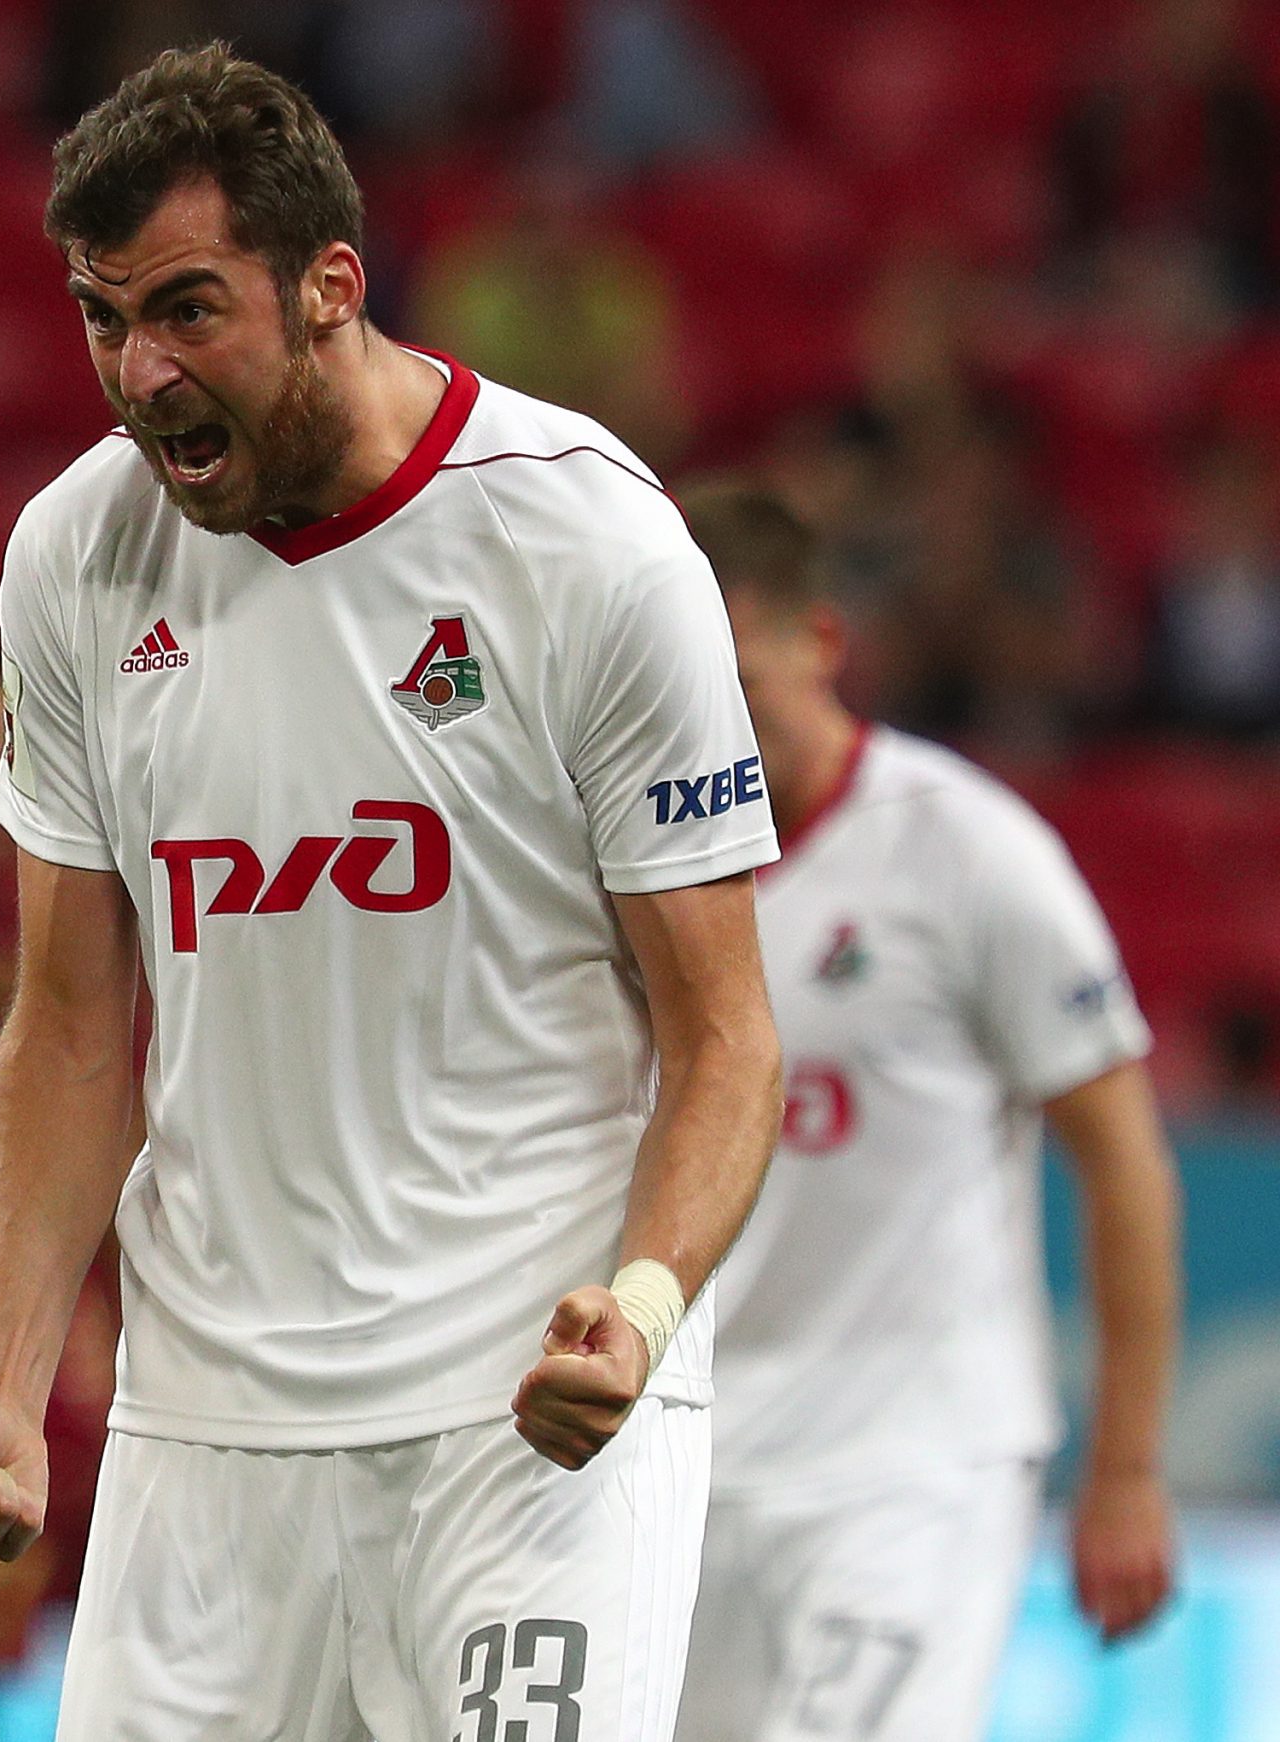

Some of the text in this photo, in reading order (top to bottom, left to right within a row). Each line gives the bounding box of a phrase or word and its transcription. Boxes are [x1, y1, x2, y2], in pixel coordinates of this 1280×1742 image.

[120, 652, 189, 673] adidas
[452, 1619, 587, 1742] 33
[792, 1612, 925, 1742] 27
